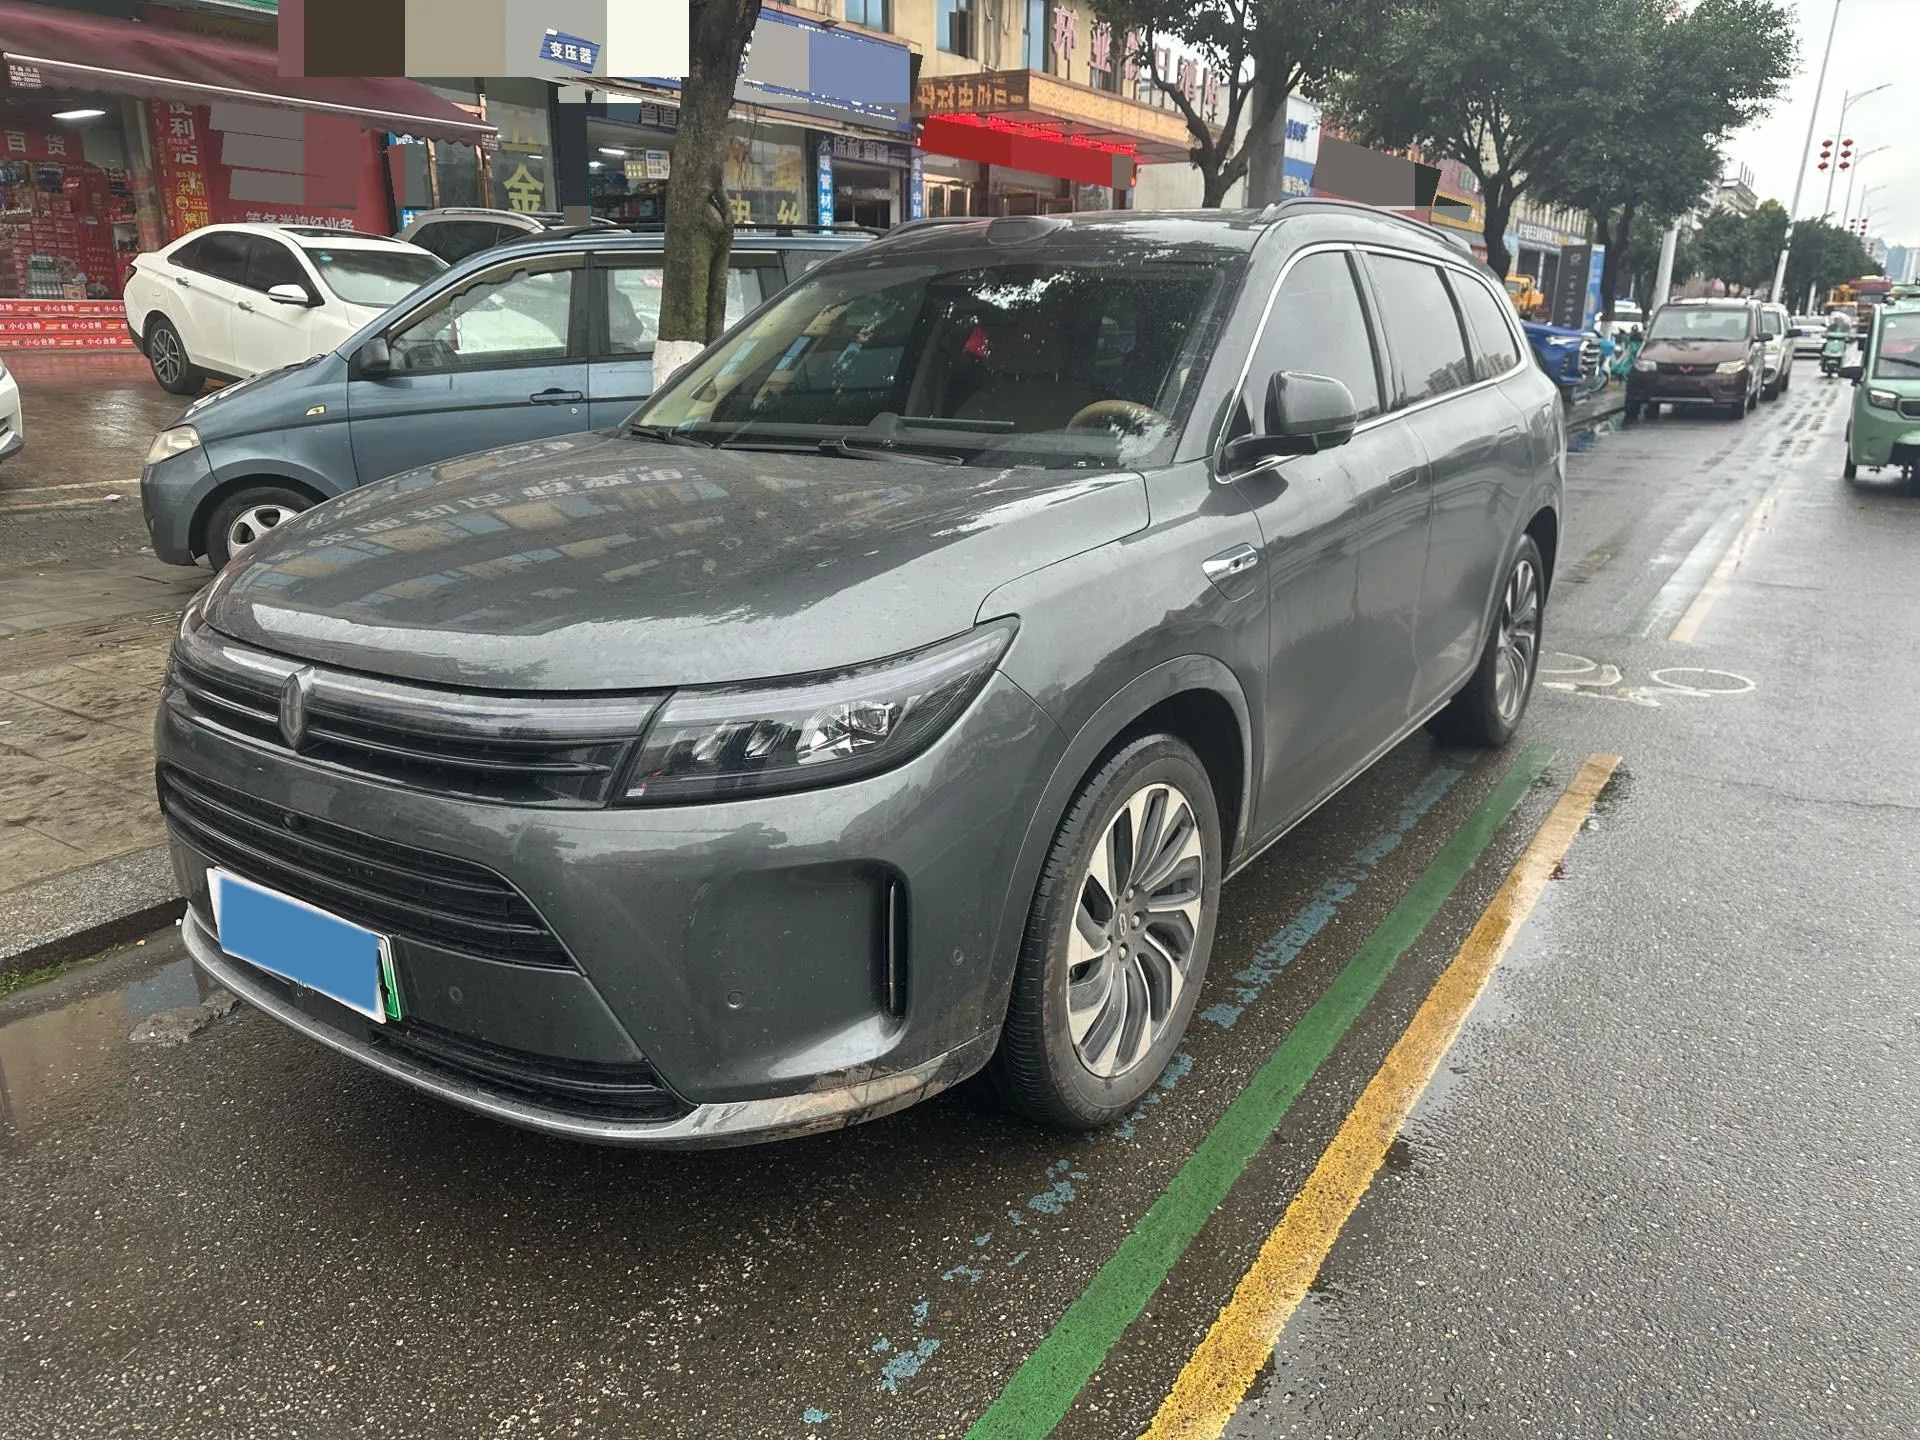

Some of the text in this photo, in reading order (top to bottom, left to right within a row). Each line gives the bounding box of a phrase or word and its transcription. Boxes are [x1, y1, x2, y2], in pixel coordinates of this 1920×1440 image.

[549, 41, 592, 64] 变压器
[4, 129, 67, 156] 百货
[45, 304, 75, 312] 小心台阶
[9, 321, 41, 329] 小心台阶
[72, 321, 102, 329] 小心台阶
[24, 337, 56, 346] 小心台阶
[87, 337, 117, 345] 小心台阶
